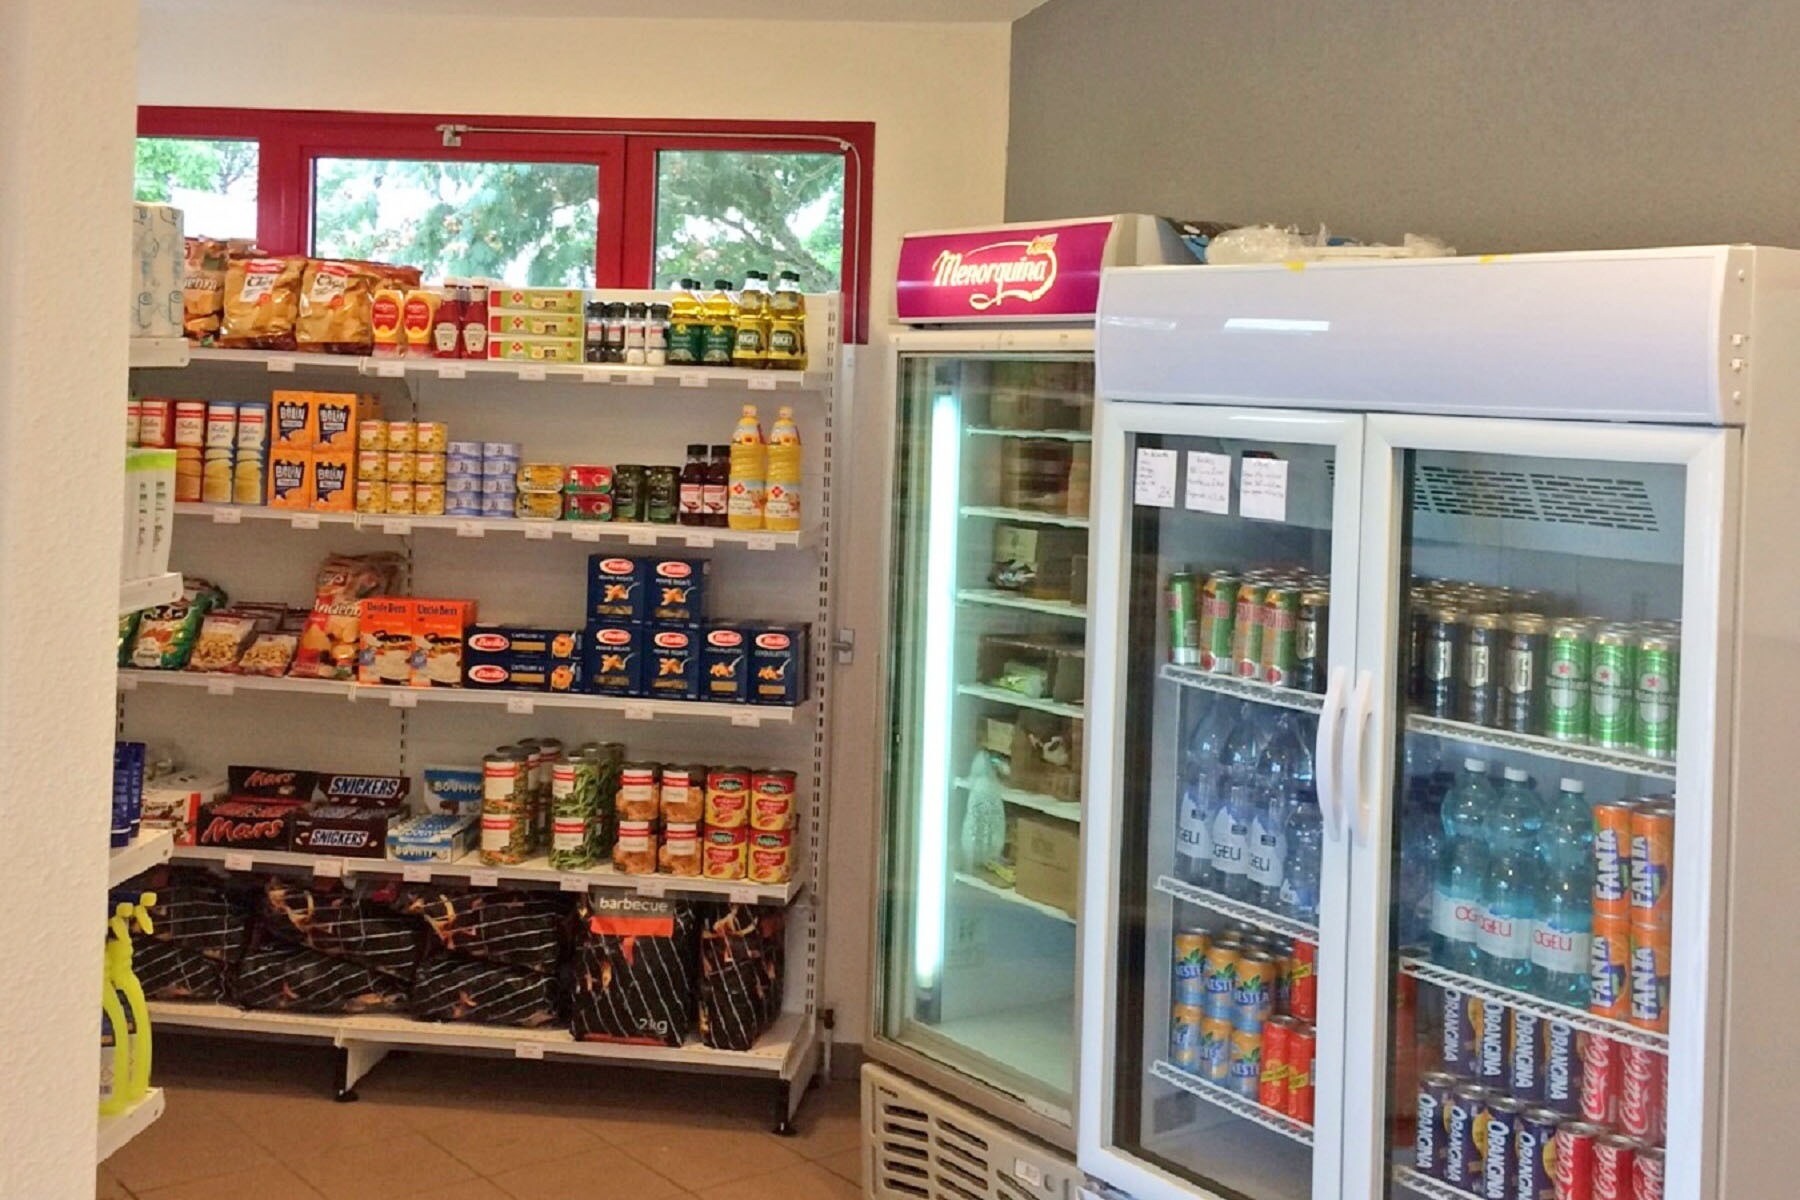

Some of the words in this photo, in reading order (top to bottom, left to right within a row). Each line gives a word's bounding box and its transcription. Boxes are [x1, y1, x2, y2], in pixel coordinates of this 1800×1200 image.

[931, 249, 1049, 304] Menorquina
[245, 770, 296, 788] Mars
[331, 778, 398, 797] SNICKERS
[201, 817, 284, 844] Mars
[312, 831, 366, 846] SNICKERS
[1595, 828, 1621, 900] FANTA
[600, 898, 668, 912] barbecue
[1631, 836, 1653, 908] FANTA
[1590, 936, 1612, 1008] FANTA
[1631, 947, 1658, 1019] FANTA
[1444, 989, 1461, 1061] ORANGINA
[1483, 1001, 1504, 1075] ORANGINA
[1515, 1011, 1537, 1087] ORANGINA
[1550, 1021, 1570, 1099] ORANGINA
[1416, 1093, 1438, 1168] ORANGINA
[1447, 1105, 1468, 1181] ORANGINA
[1486, 1121, 1510, 1199] ORANGINA
[1518, 1131, 1536, 1200] ORANGIN
